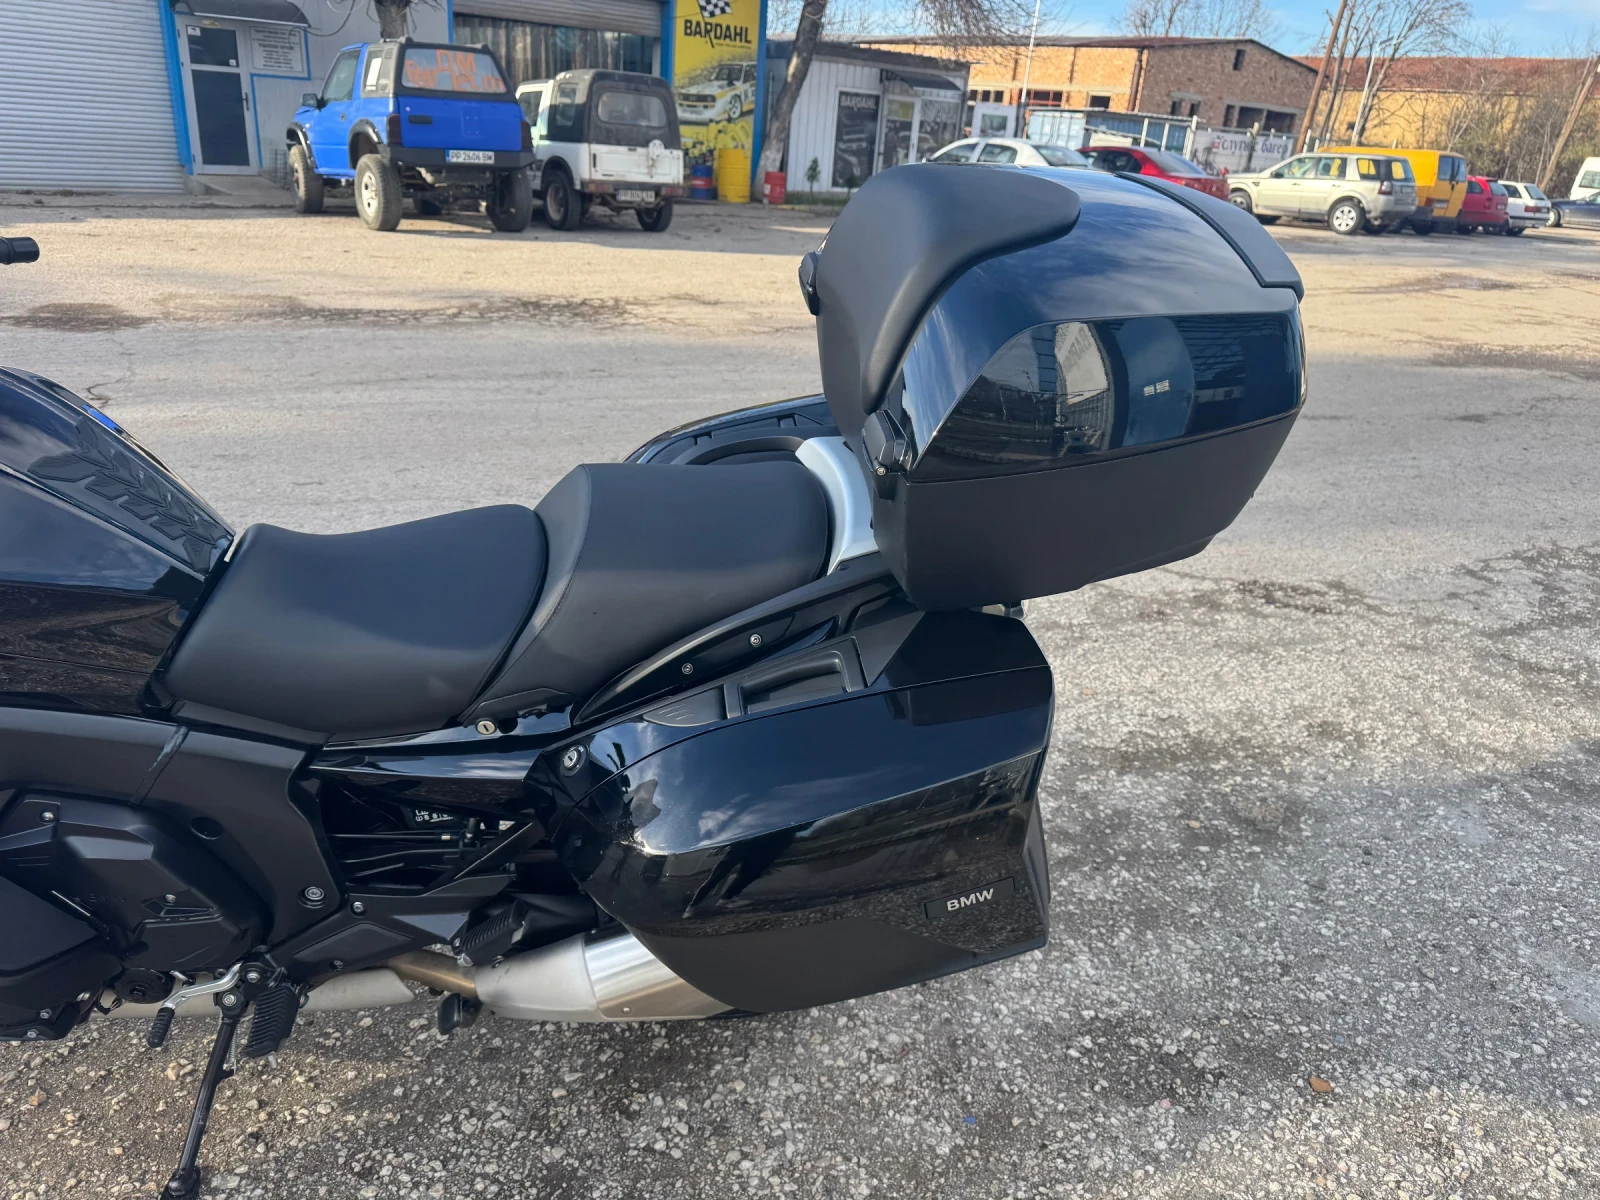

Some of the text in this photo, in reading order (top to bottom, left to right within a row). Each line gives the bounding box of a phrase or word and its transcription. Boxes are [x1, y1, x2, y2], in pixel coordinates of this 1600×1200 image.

[684, 18, 752, 44] BARDAHL
[840, 95, 877, 110] BARDAHL
[946, 888, 994, 911] BMW
